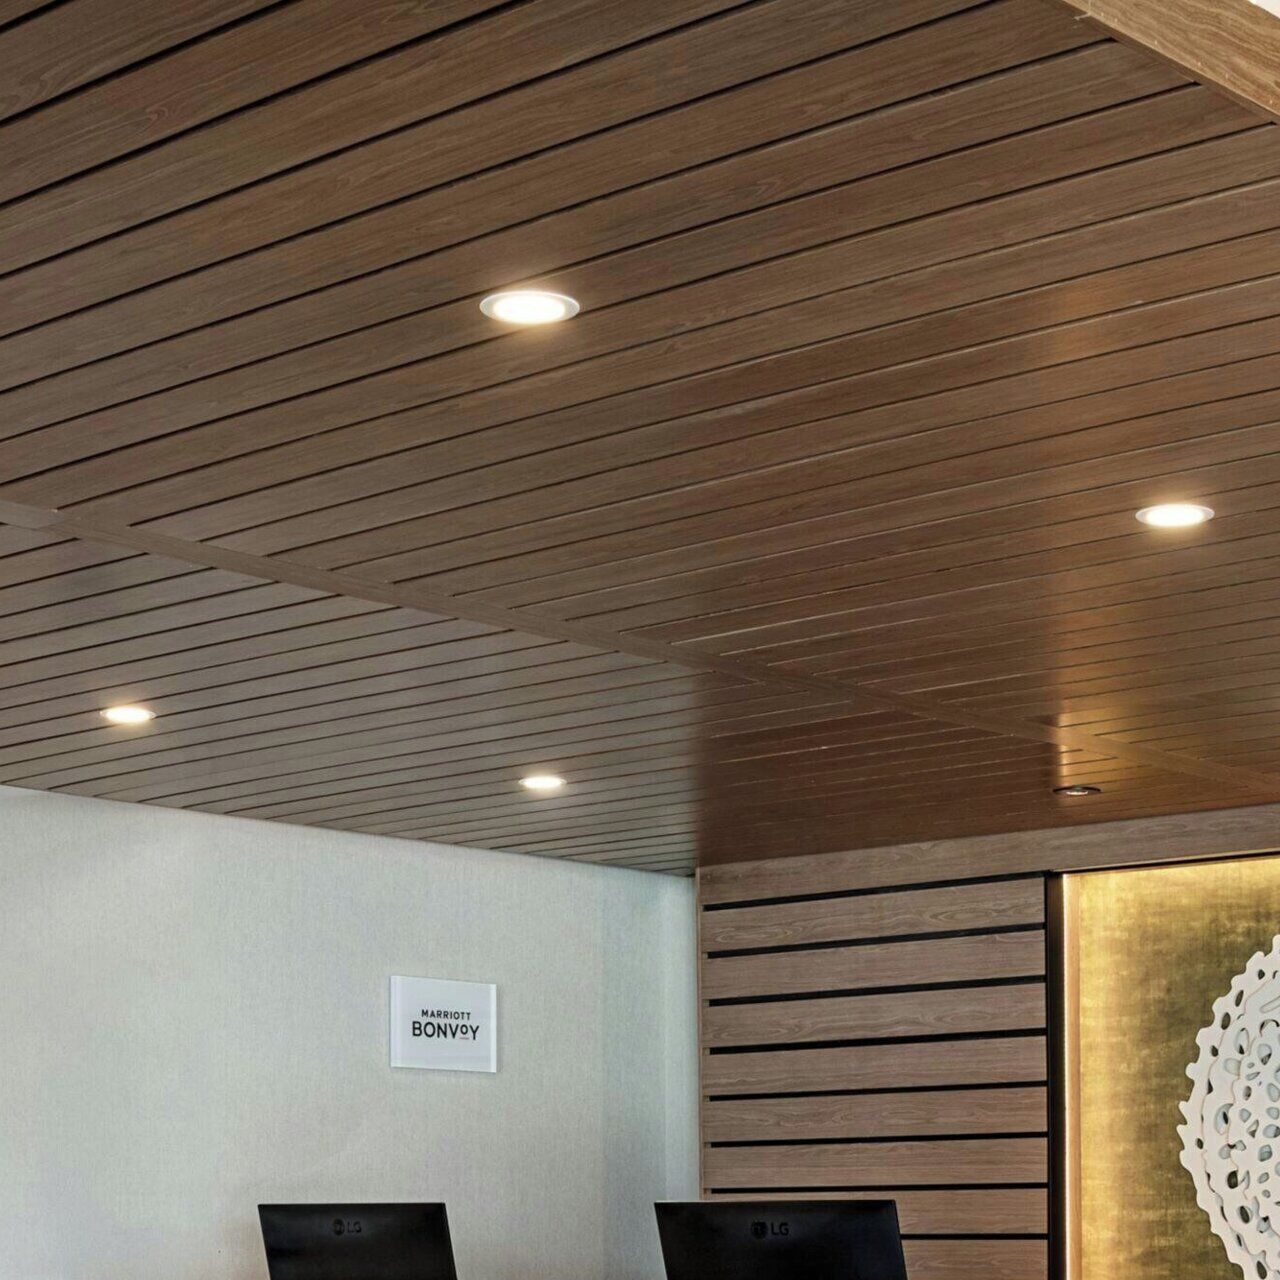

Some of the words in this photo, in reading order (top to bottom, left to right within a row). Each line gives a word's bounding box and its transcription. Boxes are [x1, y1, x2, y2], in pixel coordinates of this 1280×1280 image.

[421, 1009, 471, 1021] MARRIOTT
[412, 1020, 479, 1041] BONVOY
[347, 1220, 362, 1233] LG
[771, 1221, 789, 1236] LG
